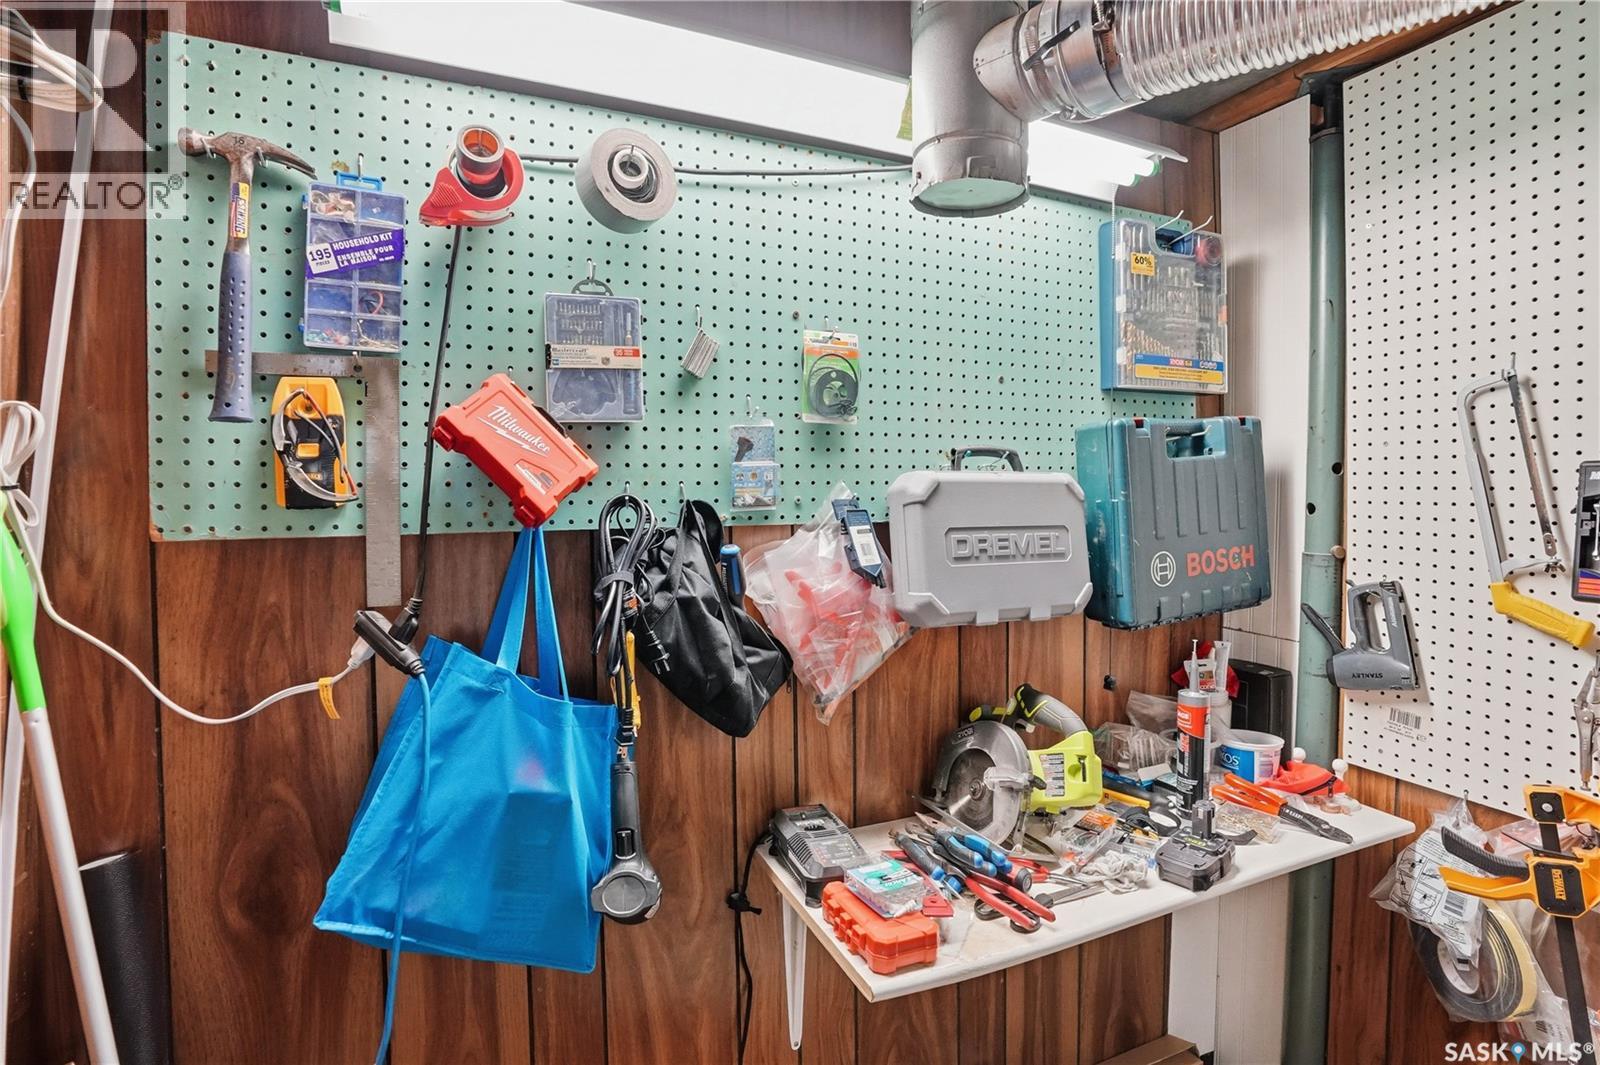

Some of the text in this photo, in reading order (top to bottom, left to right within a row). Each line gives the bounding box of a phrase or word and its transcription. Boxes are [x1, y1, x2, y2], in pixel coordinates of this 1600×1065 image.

[332, 231, 393, 251] HOUSEHOLD KIT
[308, 248, 332, 262] 195
[337, 249, 374, 261] ENSEMBLE
[374, 244, 394, 255] POUR
[350, 253, 377, 265] MAISON
[1134, 256, 1152, 266] 60%
[487, 404, 551, 453] Milwaukee
[951, 532, 1066, 560] DREMEL
[1185, 544, 1256, 577] BOSCH
[1352, 672, 1384, 680] STANLEY
